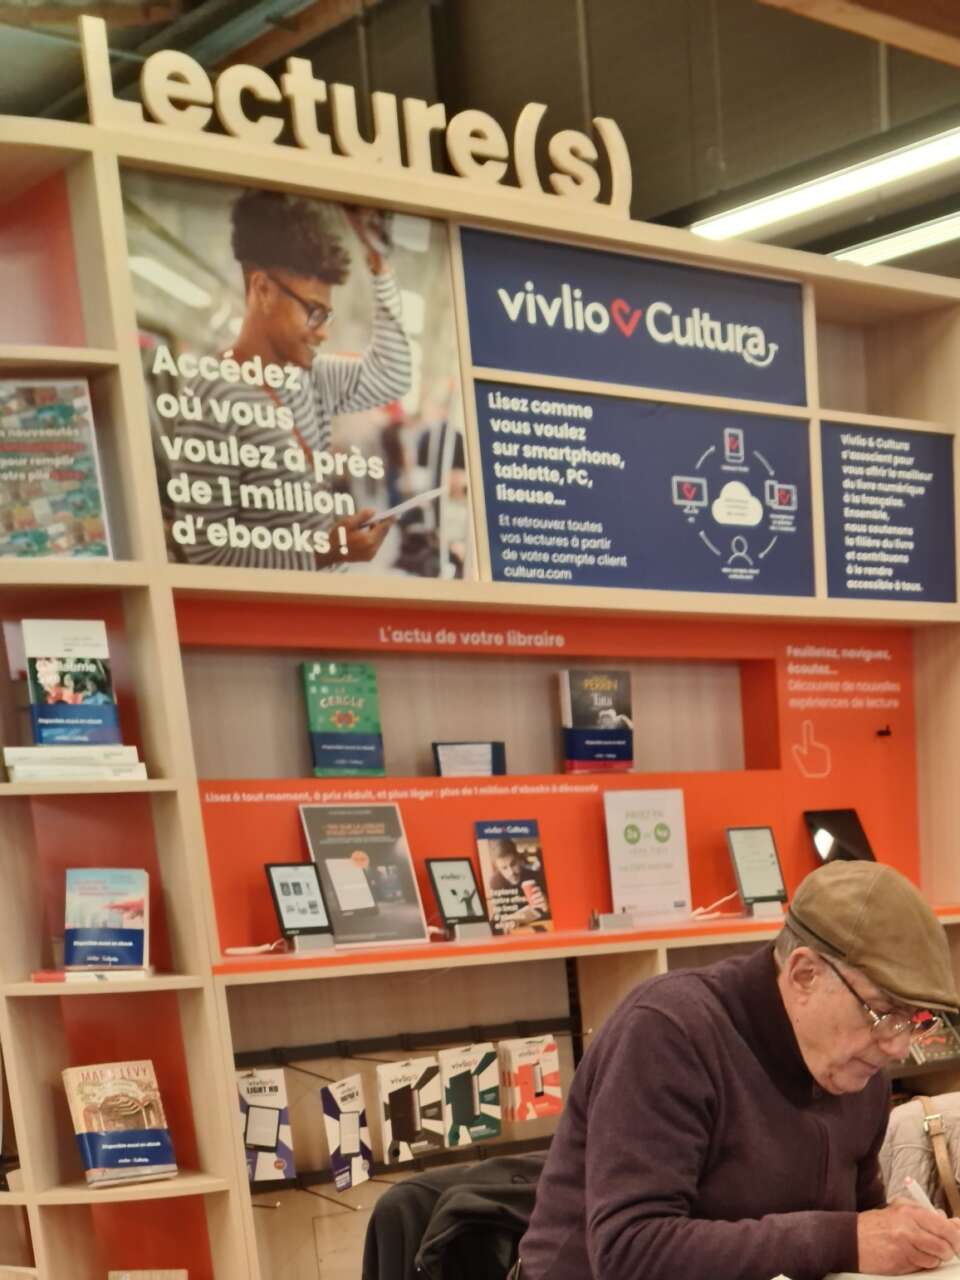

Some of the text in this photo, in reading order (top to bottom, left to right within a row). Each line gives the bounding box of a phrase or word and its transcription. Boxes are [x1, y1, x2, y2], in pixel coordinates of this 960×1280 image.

[80, 15, 633, 220] Lecture(s)
[497, 281, 779, 367] vivlio Cultura
[152, 345, 301, 391] Accédez
[156, 387, 294, 430] où vous
[488, 392, 593, 420] Lisez comme
[490, 418, 586, 441] vous voulez
[160, 435, 385, 483] voulez à près
[492, 441, 625, 469] sur smartphone,
[494, 462, 593, 489] tablette, PC,
[167, 473, 355, 516] de 1 million
[172, 514, 331, 554] d'ebooks
[512, 515, 565, 530] retrouvez
[567, 519, 603, 532] toutes
[500, 533, 521, 543] vos
[523, 533, 569, 547] lectures
[581, 537, 611, 550] partir
[502, 549, 627, 567] de votre compte client
[504, 564, 572, 580] cultura.com
[379, 625, 565, 648] L'actu de votre libraire
